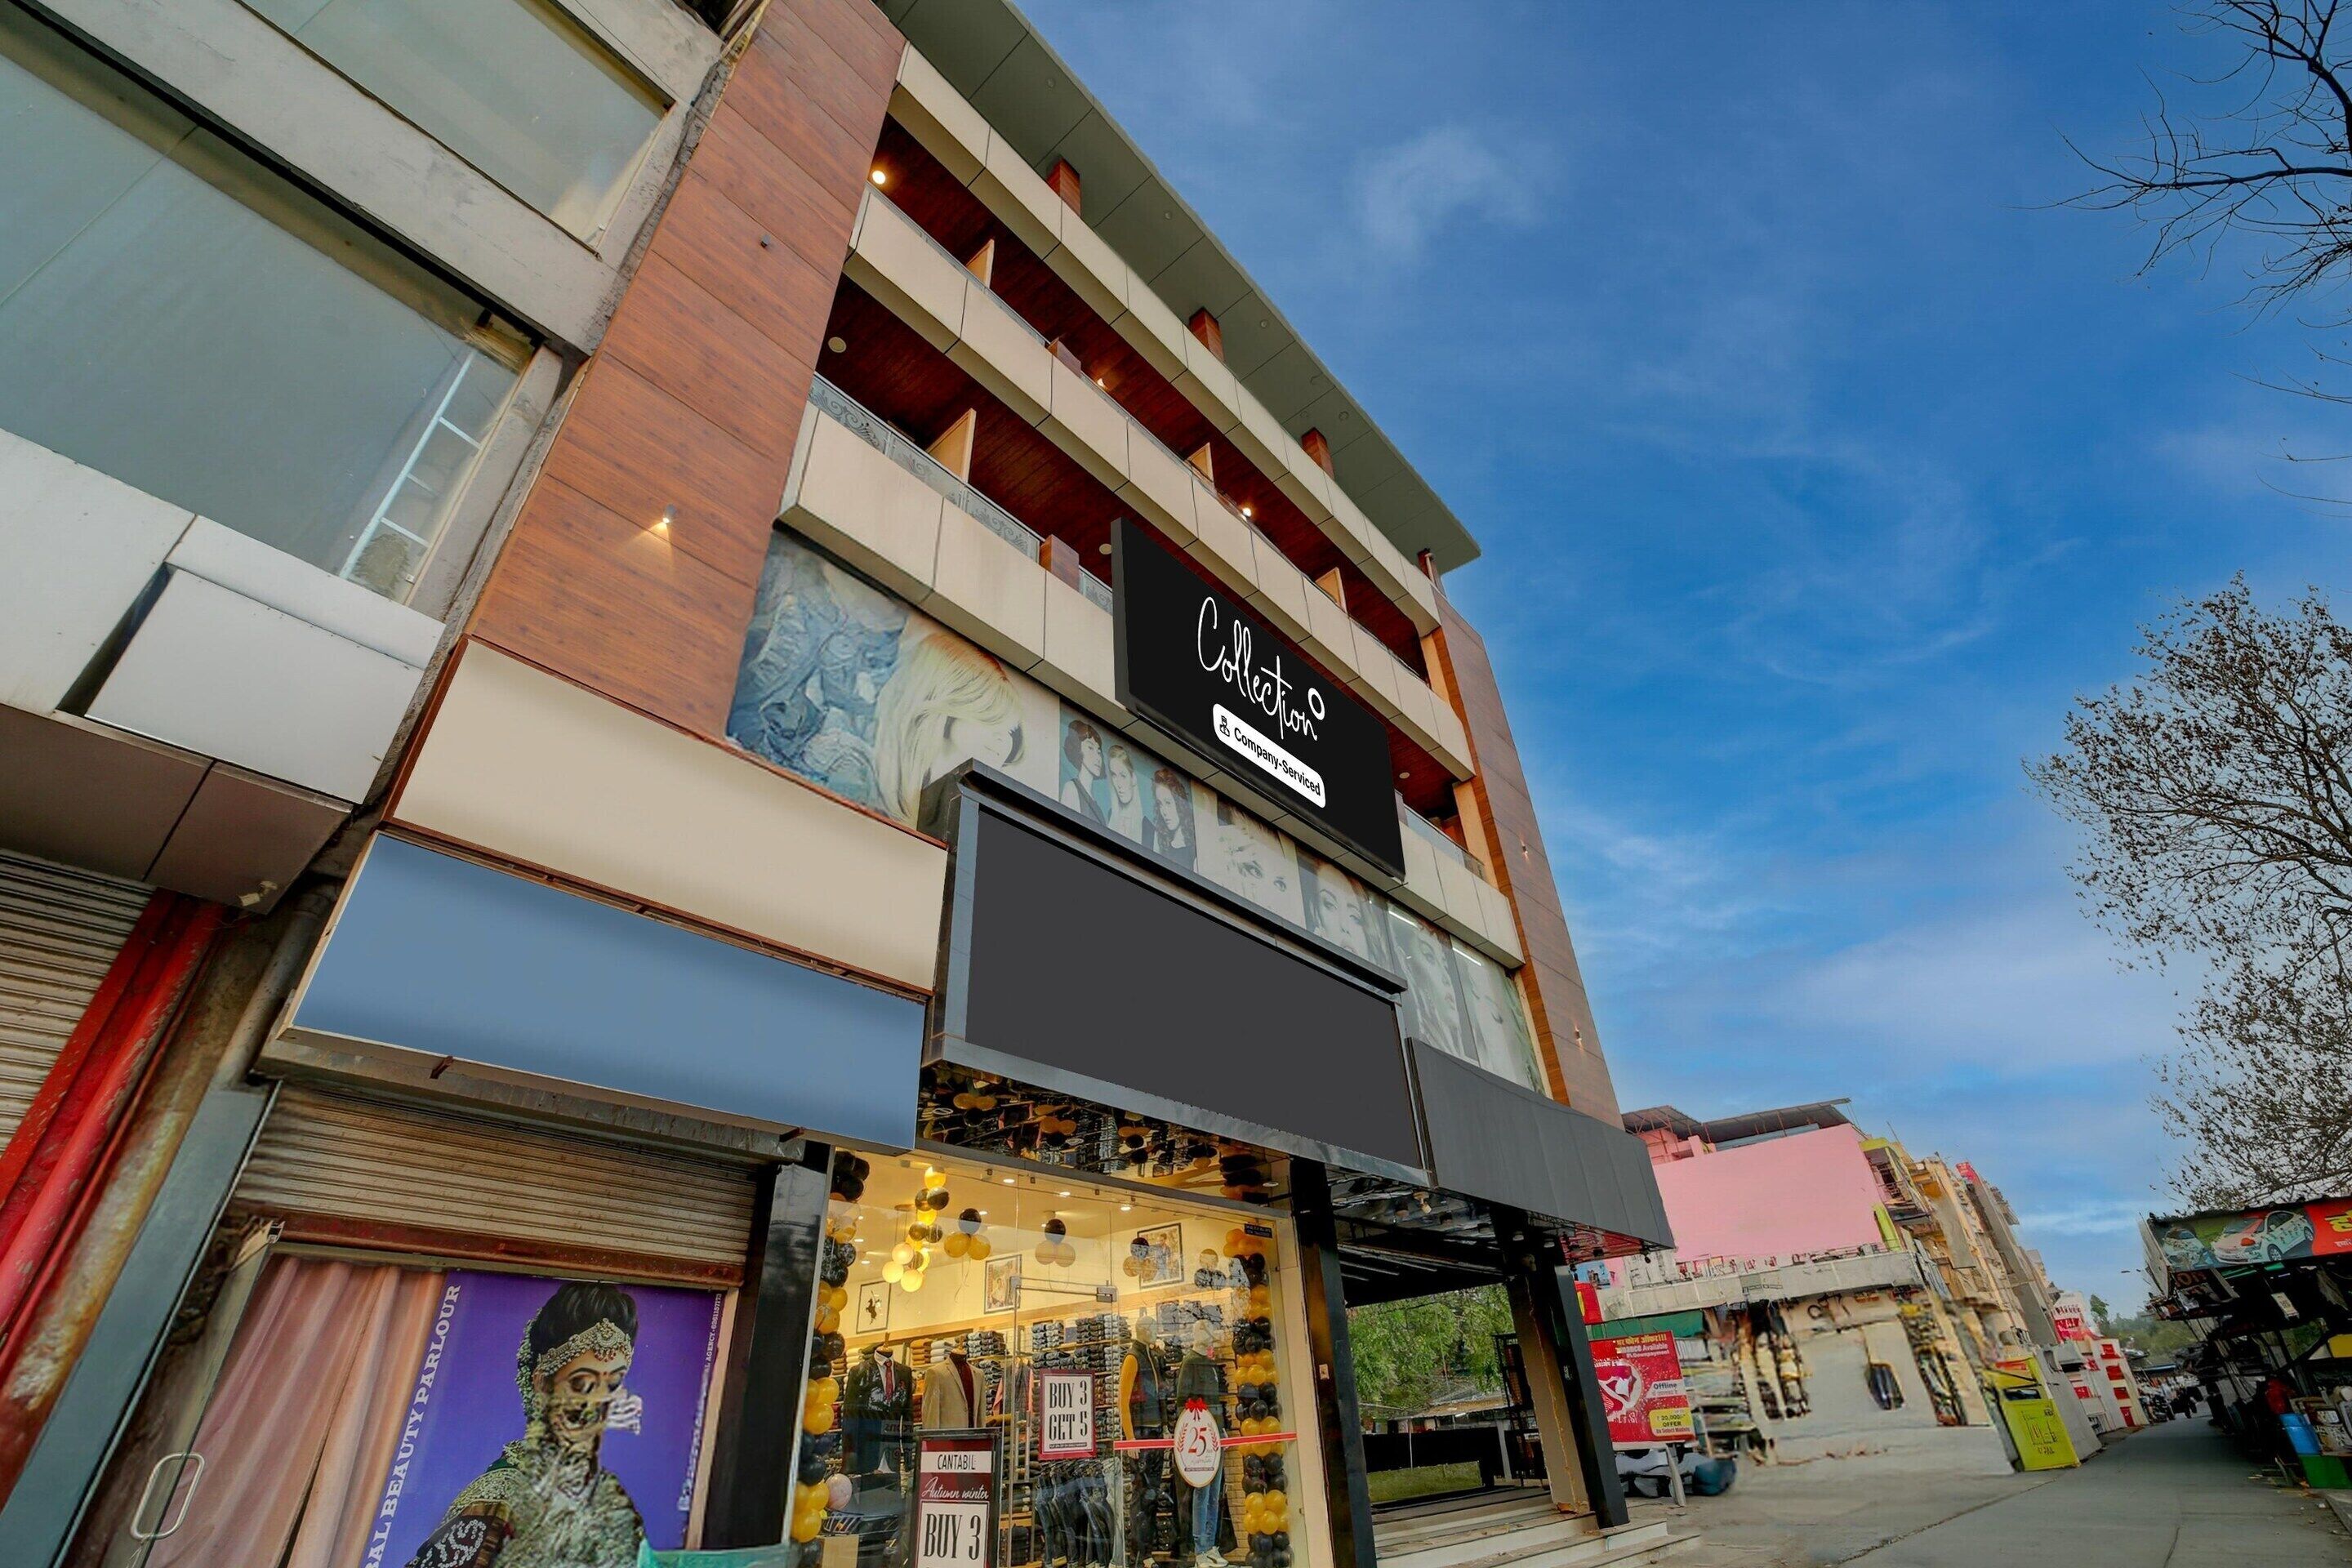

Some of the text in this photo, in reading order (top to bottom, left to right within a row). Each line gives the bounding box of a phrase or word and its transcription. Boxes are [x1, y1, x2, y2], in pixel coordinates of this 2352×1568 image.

[1234, 726, 1321, 796] Company-Serviced
[381, 1408, 424, 1520] BEAUTY
[414, 1284, 461, 1405] PARLOUR
[1049, 1380, 1087, 1409] BUY 3
[1049, 1411, 1088, 1441] GET 5
[1188, 1427, 1207, 1456] 25
[937, 1454, 976, 1470] CANTABIL
[921, 1476, 989, 1500] Autumn winter
[923, 1513, 981, 1560] BUY 3
